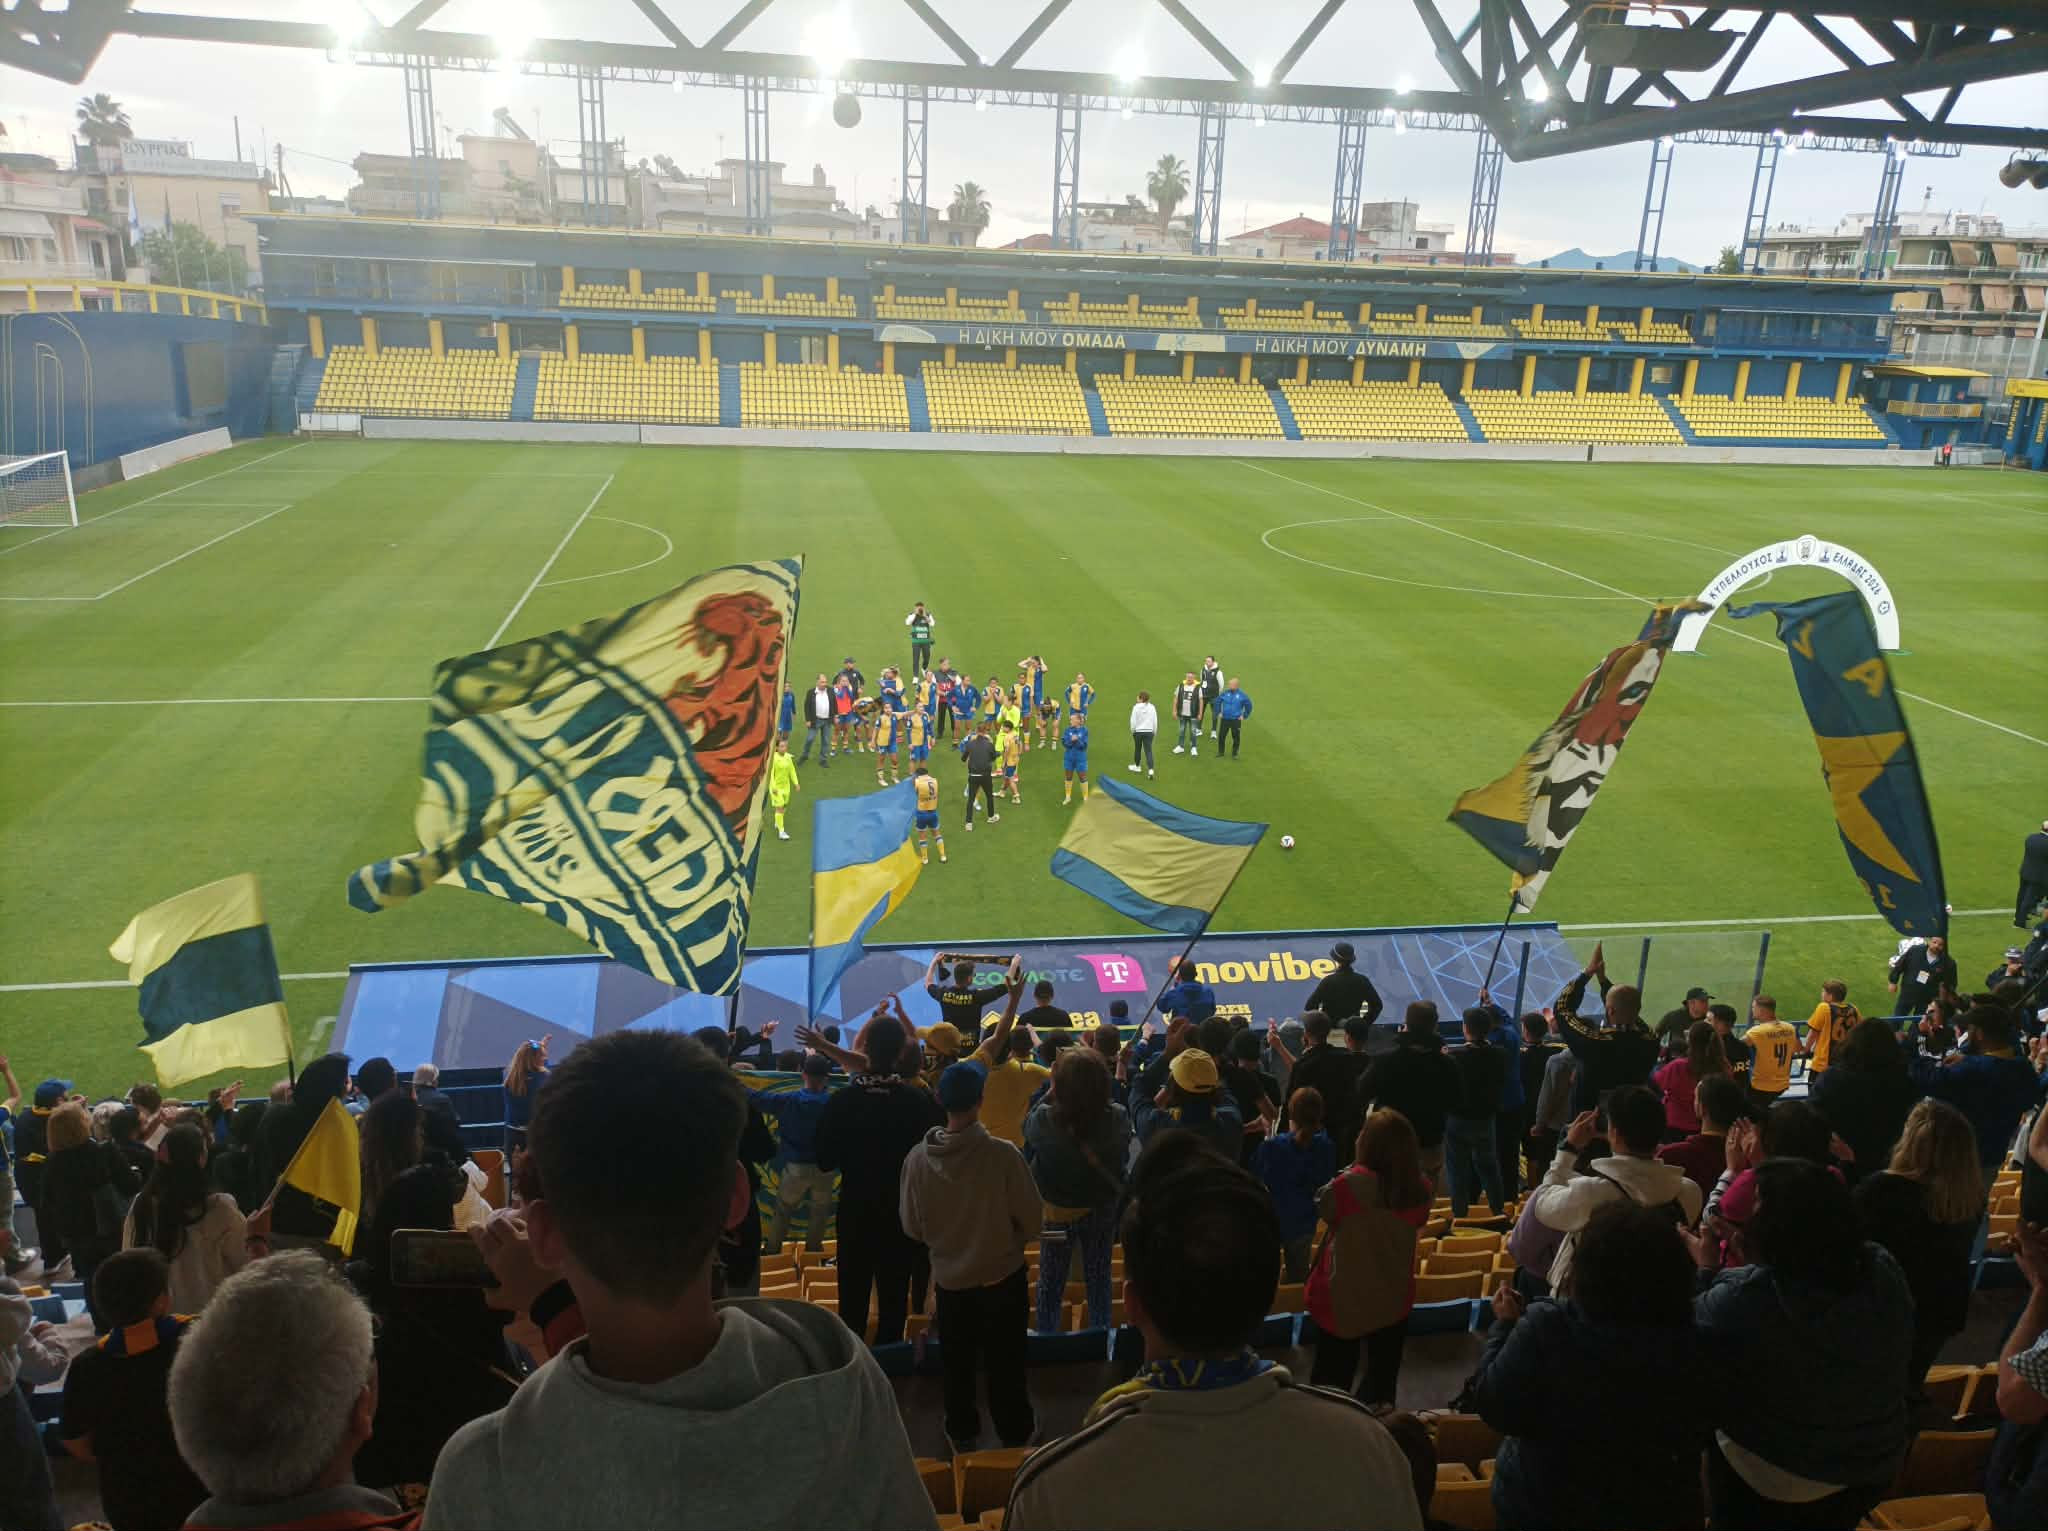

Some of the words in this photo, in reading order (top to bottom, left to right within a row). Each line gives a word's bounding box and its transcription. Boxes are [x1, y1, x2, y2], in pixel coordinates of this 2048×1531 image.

[959, 328, 970, 344] Η
[975, 328, 1014, 345] ΔΙΚΗ
[1020, 330, 1057, 346] ΜΟΥ
[1062, 332, 1126, 349] ΟΜΑΔΑ
[1255, 337, 1266, 352] Η
[1270, 337, 1308, 354] ΔΙΚΗ
[1312, 339, 1349, 355] ΜΟΥ
[1355, 340, 1427, 357] ΔΥΝΑΜΗ
[1102, 961, 1129, 984] T
[1194, 951, 1338, 985] novibe
